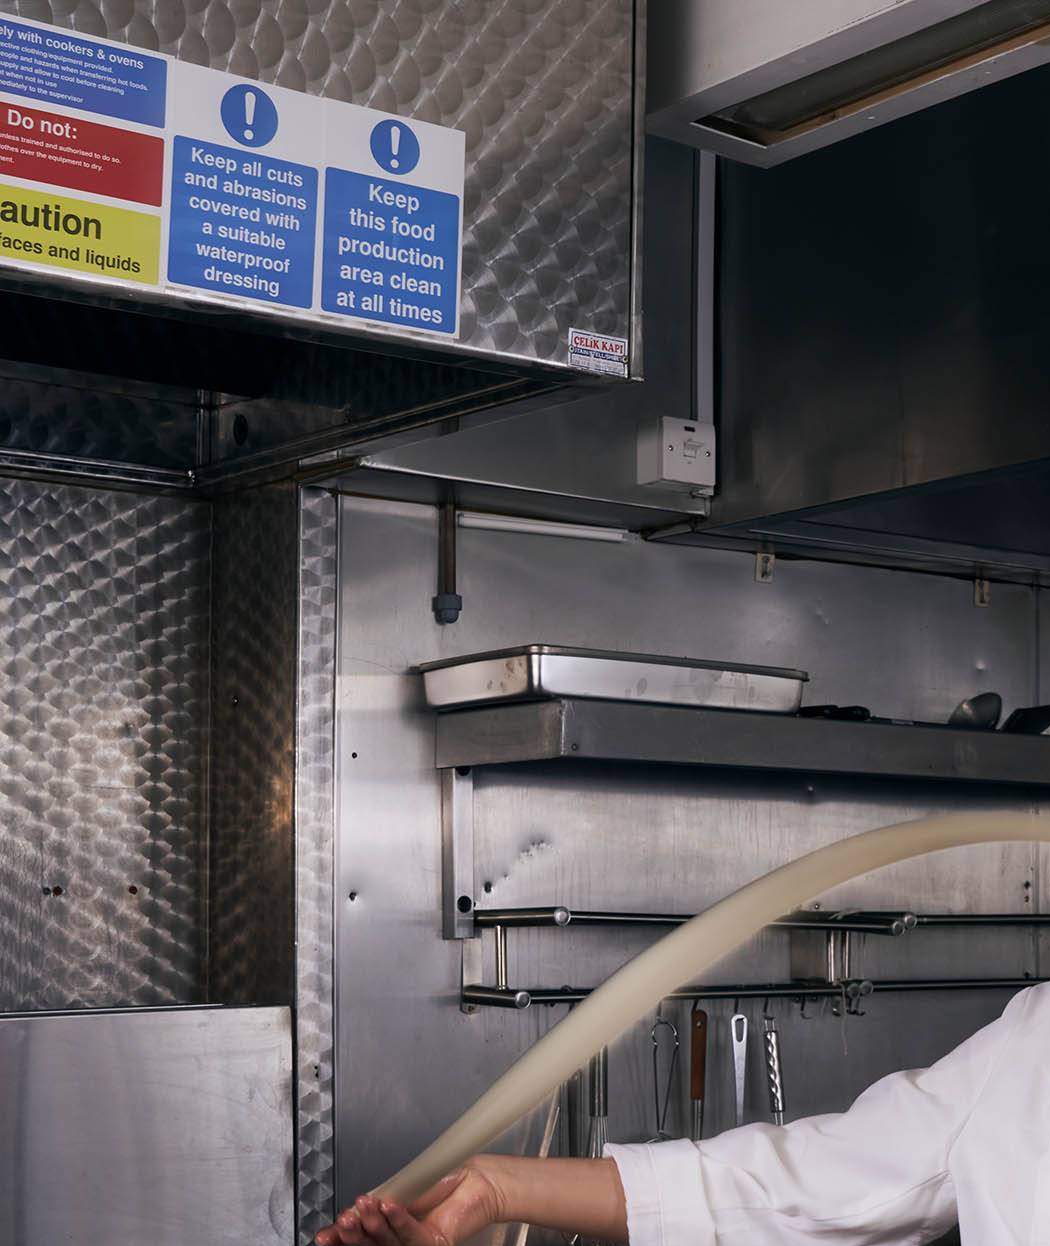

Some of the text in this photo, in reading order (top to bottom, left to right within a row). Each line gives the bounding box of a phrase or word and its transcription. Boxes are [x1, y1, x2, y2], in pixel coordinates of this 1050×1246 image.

[17, 31, 42, 44] with
[45, 38, 93, 57] cookers
[97, 49, 106, 60] &
[109, 54, 144, 70] ovens
[5, 71, 23, 79] when
[24, 75, 36, 83] not
[45, 80, 57, 88] use
[34, 59, 60, 70] hazards
[61, 65, 78, 74] when
[118, 78, 128, 86] hot
[34, 68, 51, 77] allow
[76, 78, 96, 88] before
[98, 83, 125, 96] cleaning
[8, 109, 77, 139] Do not:
[20, 148, 35, 156] over
[36, 150, 47, 159] the
[48, 155, 82, 166] equipment
[21, 136, 44, 147] trained
[45, 142, 58, 150] and
[191, 147, 304, 187] Keep all cuts
[184, 172, 307, 210] and abrasions
[369, 183, 420, 214] Keep
[0, 201, 101, 240] aution
[189, 196, 300, 231] covered with
[349, 208, 435, 242] this food
[202, 222, 286, 250] a suitable
[0, 232, 141, 273] aces and liquids
[196, 243, 291, 273] waterproof
[338, 236, 444, 270] production
[204, 266, 280, 297] dressing
[340, 265, 441, 297] area clean
[336, 290, 443, 324] at all times
[601, 341, 623, 354] KAPI
